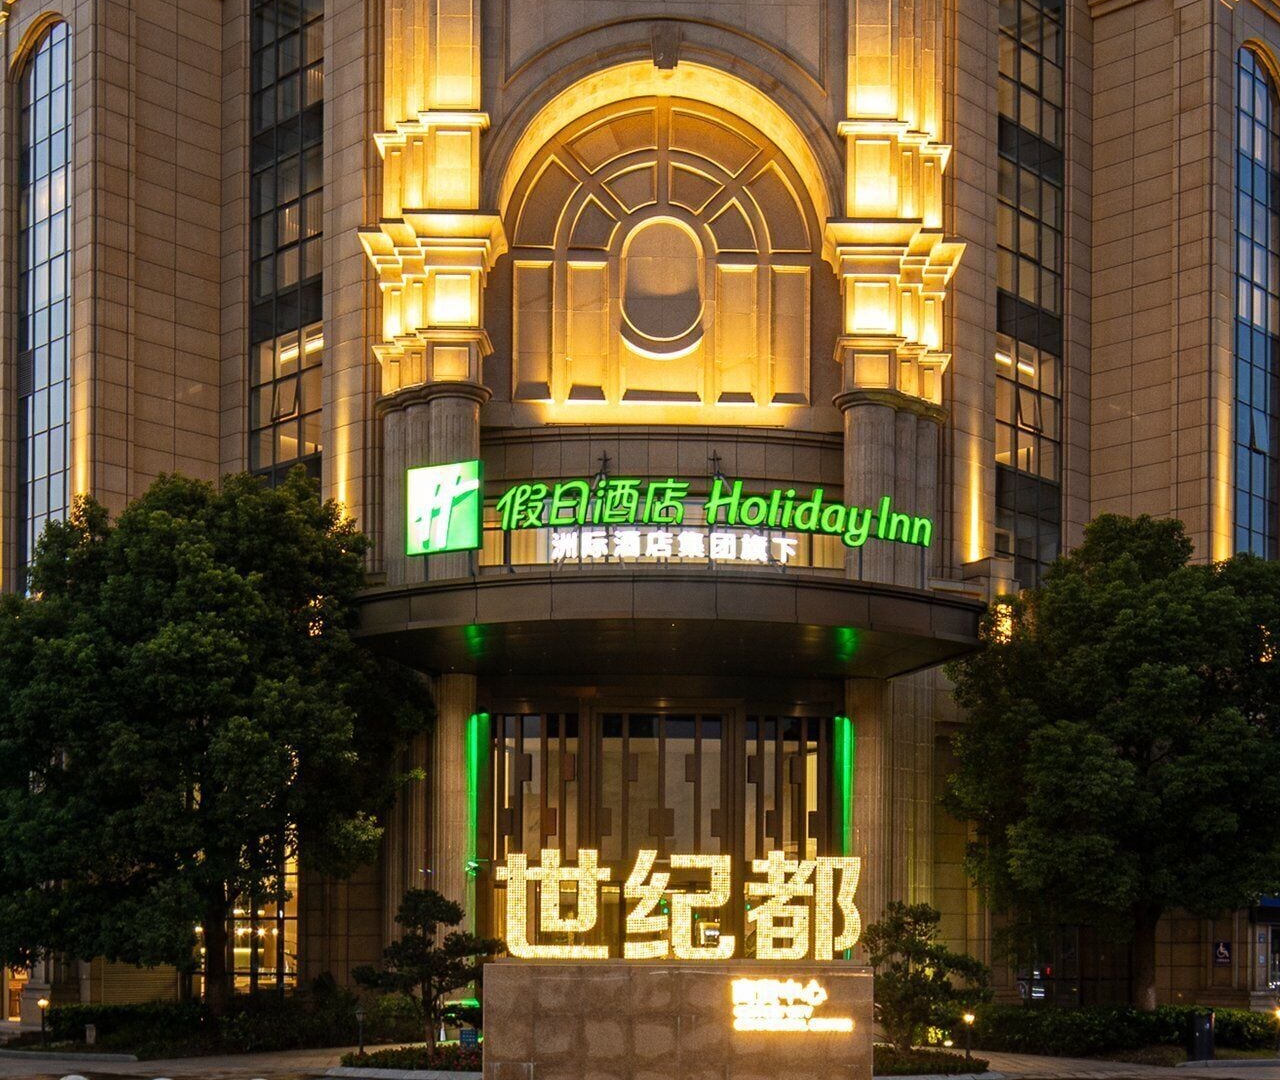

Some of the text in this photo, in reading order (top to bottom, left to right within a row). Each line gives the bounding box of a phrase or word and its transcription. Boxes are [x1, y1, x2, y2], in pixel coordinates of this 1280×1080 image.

[496, 477, 690, 531] 假日酒店
[704, 478, 934, 548] Holiday Inn
[551, 529, 798, 564] 洲际酒店集团旗下
[495, 848, 862, 961] 世纪都
